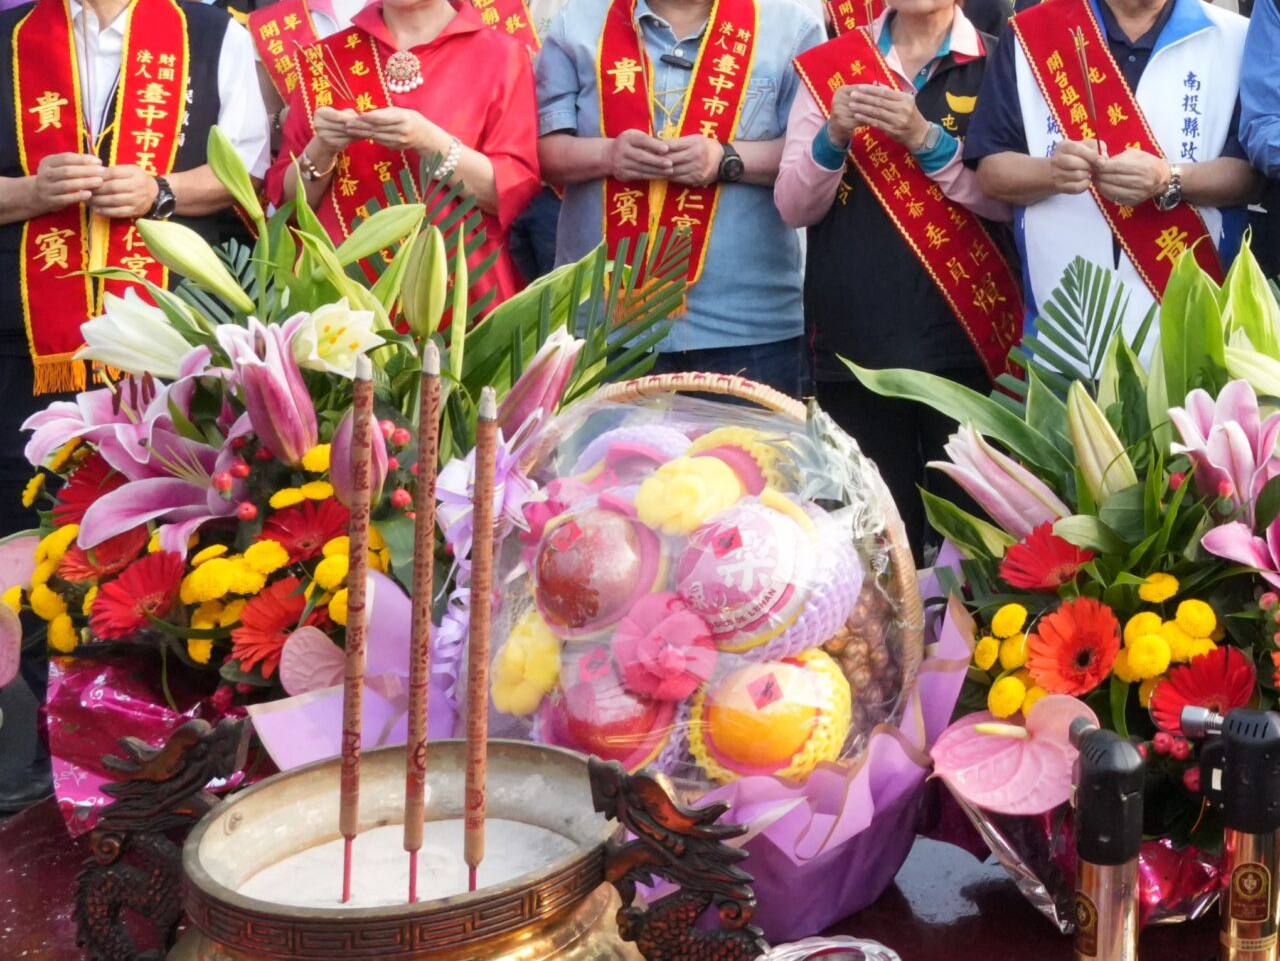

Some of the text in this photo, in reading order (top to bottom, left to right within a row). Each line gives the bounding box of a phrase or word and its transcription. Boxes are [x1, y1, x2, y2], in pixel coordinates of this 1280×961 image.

[134, 49, 154, 79] 法人
[158, 53, 177, 81] 財團
[714, 20, 734, 51] 法人
[732, 27, 751, 56] 財團
[607, 56, 645, 227] 貴賓
[671, 52, 740, 237] 臺中市玉仁宮
[1180, 71, 1201, 162] 南投縣政
[28, 91, 76, 272] 貴賓
[120, 82, 172, 277] 臺中市玉仁宮
